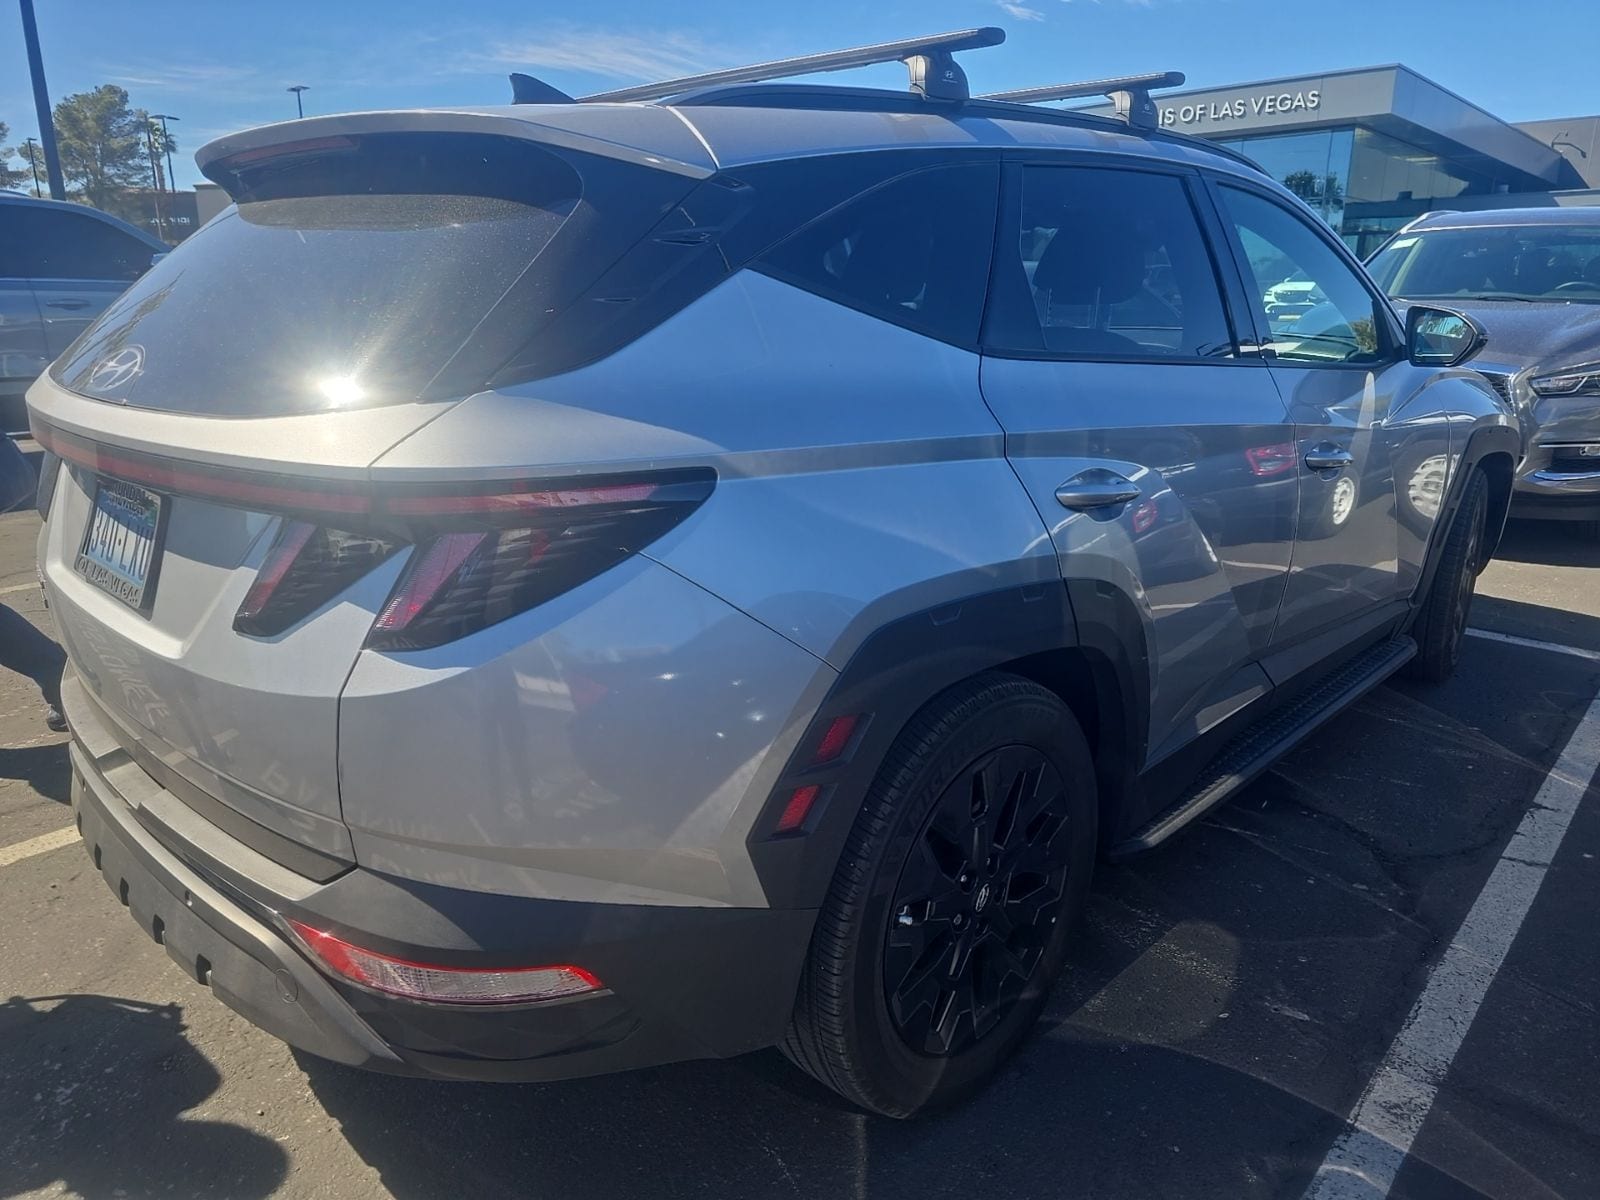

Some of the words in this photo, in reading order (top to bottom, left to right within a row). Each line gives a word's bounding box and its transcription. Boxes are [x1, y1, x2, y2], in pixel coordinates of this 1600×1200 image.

[1180, 104, 1205, 122] OF
[1210, 100, 1245, 119] LAS
[1251, 90, 1319, 113] VEGAS
